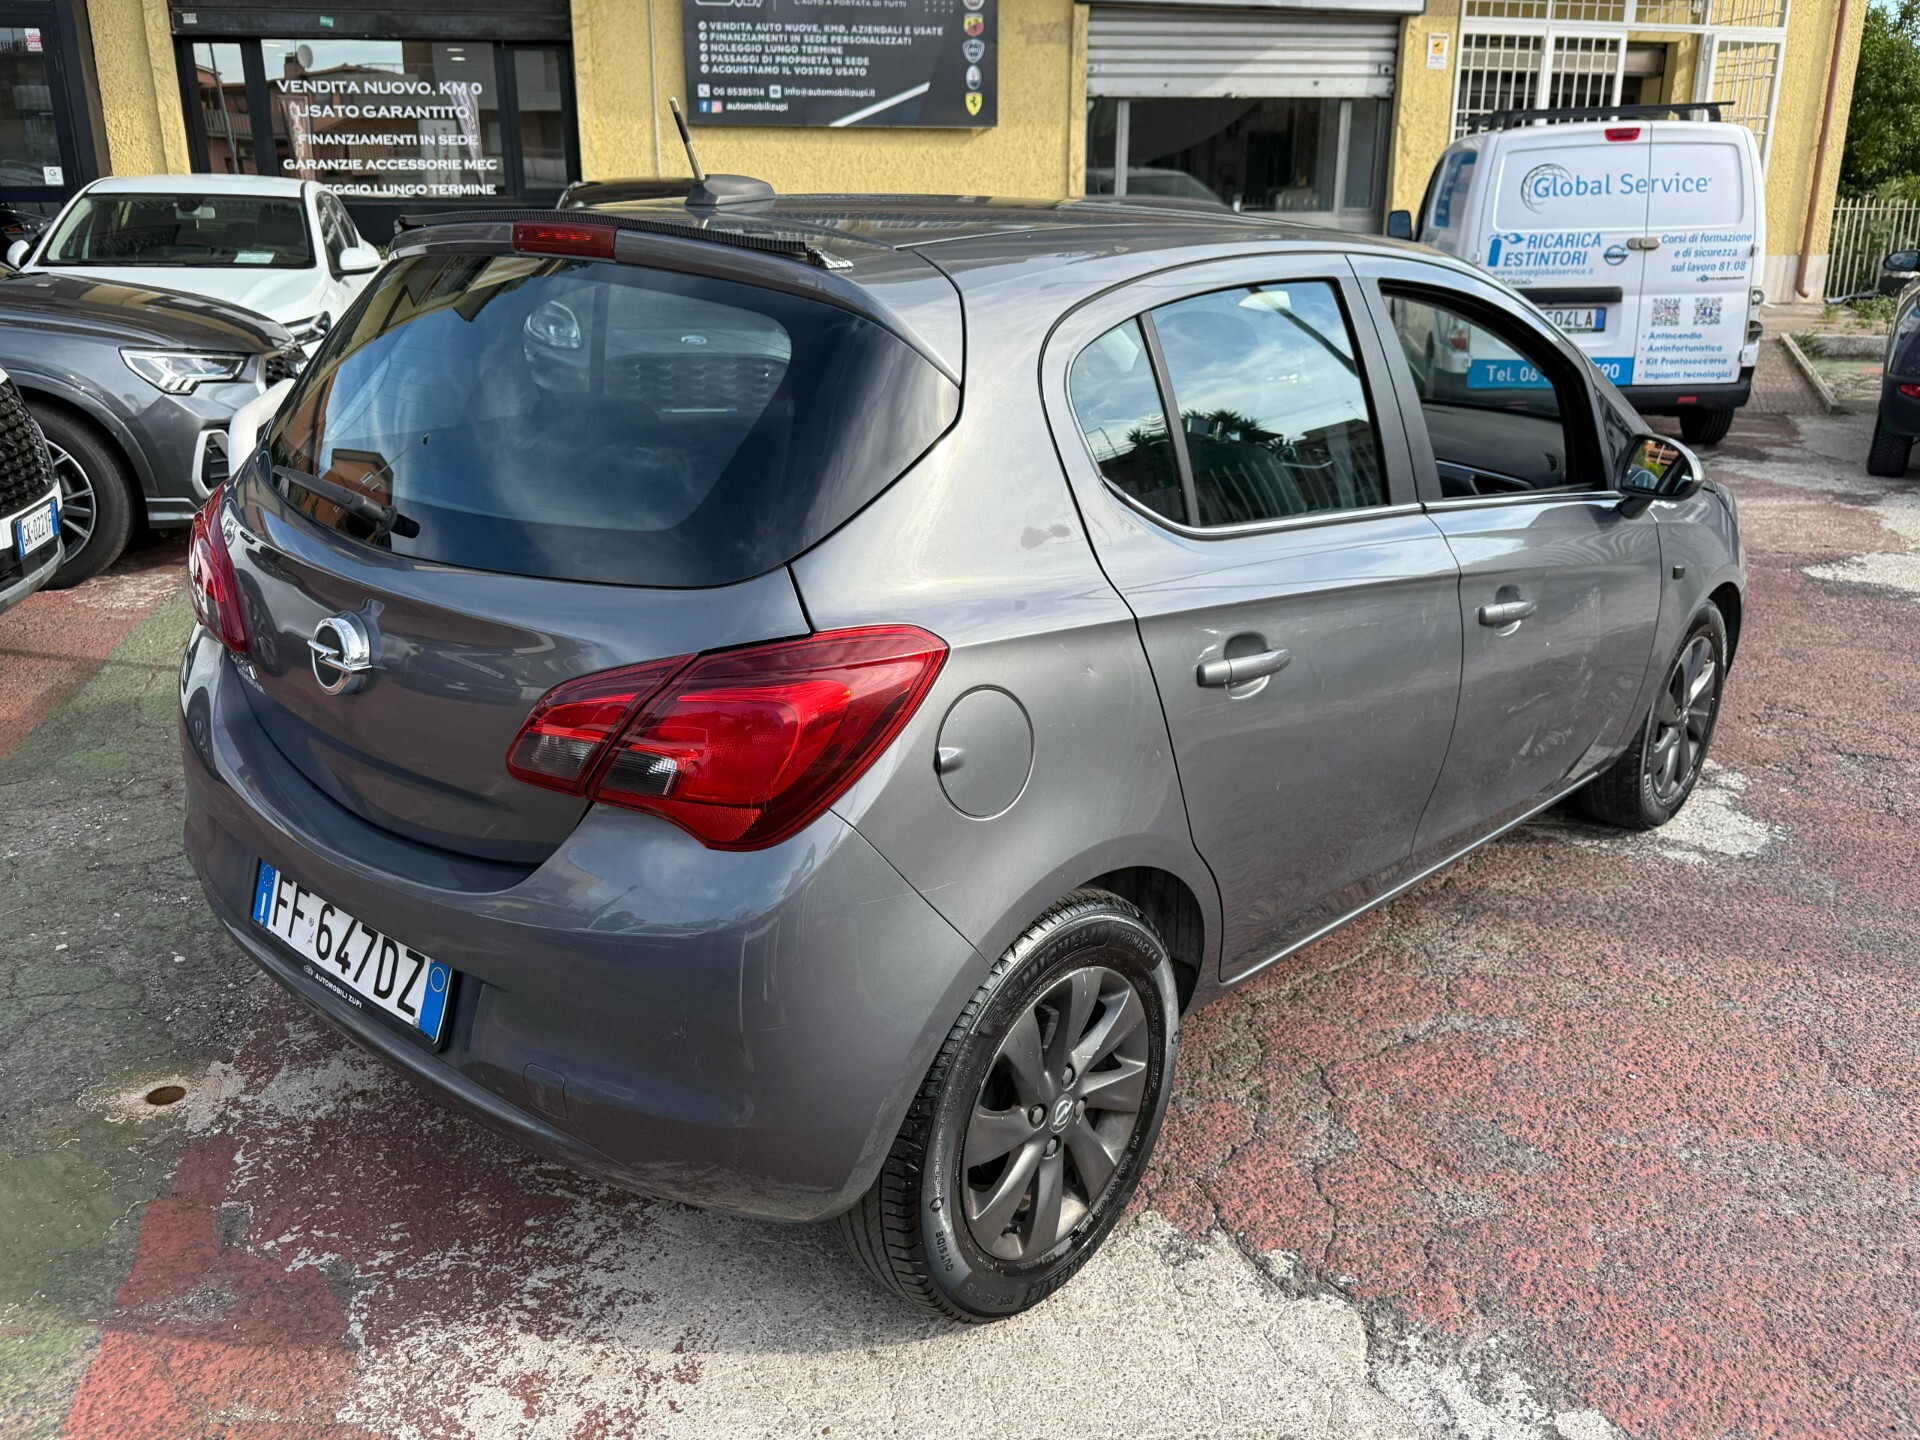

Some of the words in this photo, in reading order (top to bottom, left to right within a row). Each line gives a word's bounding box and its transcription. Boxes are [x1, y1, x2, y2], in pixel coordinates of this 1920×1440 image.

[709, 22, 753, 31] VENDITA
[755, 23, 782, 31] AUTO
[785, 23, 821, 33] NUOVE,
[851, 25, 902, 34] AZIENDALI
[905, 26, 911, 35] E
[913, 26, 943, 36] USATE
[709, 33, 787, 42] FINANZIAMENTI
[790, 34, 800, 43] IN
[803, 34, 828, 43] SEDE
[831, 35, 912, 45] PERSONALIZZATI
[710, 43, 762, 52] NOLEGGIO
[765, 44, 799, 53] LUNGO
[801, 45, 843, 55] TERMINE
[711, 54, 759, 63] PASSAGGI
[762, 55, 773, 64] DI
[775, 55, 829, 65] PROPRIETÀ
[832, 56, 843, 65] IN
[845, 57, 870, 66] SEDE
[711, 64, 780, 75] ACQUISTIAMO
[782, 66, 791, 75] IL
[794, 66, 833, 76] VOSTRO
[835, 67, 867, 77] USATO
[277, 80, 361, 94] VENDITA
[364, 81, 436, 96] NUOVO,
[440, 81, 467, 95] KM
[298, 104, 359, 118] USATO
[362, 105, 470, 119] GARANTITO
[298, 134, 418, 145] FINANZIAMENTI
[420, 134, 436, 146] IN
[438, 134, 479, 146] SEDE
[283, 158, 363, 170] GARANZIE
[365, 159, 462, 171] ACCESSORIE
[464, 159, 498, 170] MEC
[321, 184, 371, 195] EGGIO
[373, 184, 427, 195] LUNGO
[428, 184, 497, 195] TERMINE
[1533, 173, 1612, 198] Global
[1620, 172, 1709, 195] Service
[1527, 233, 1602, 249] RICARICA
[1661, 233, 1686, 244] Corsi
[1689, 233, 1698, 243] di
[1700, 232, 1752, 243] formazione
[1503, 251, 1588, 267] ESTINTORI
[1674, 250, 1681, 258] e
[1682, 248, 1691, 258] di
[1694, 248, 1737, 258] sicurezza
[1670, 262, 1685, 272] sul
[1687, 262, 1717, 272] lavoro
[1719, 261, 1746, 271] 81.08
[1648, 332, 1702, 340] Antincendio
[1647, 344, 1722, 352] Antinfortunistica
[1645, 357, 1658, 366] Kit
[1660, 356, 1727, 366] Prontosoccorso
[1486, 365, 1515, 382] Tel.
[1520, 367, 1538, 381] 06
[1596, 363, 1620, 379] 90
[1644, 371, 1680, 380] Impianti
[1683, 370, 1732, 379] tecnologici
[273, 874, 310, 938] FF
[316, 903, 425, 1017] 647DZ
[1119, 930, 1153, 959] PRIMACY
[314, 973, 348, 999] AUTOMOBILI
[348, 995, 362, 1008] ZUPI
[936, 1230, 954, 1272] OUTSIDE
